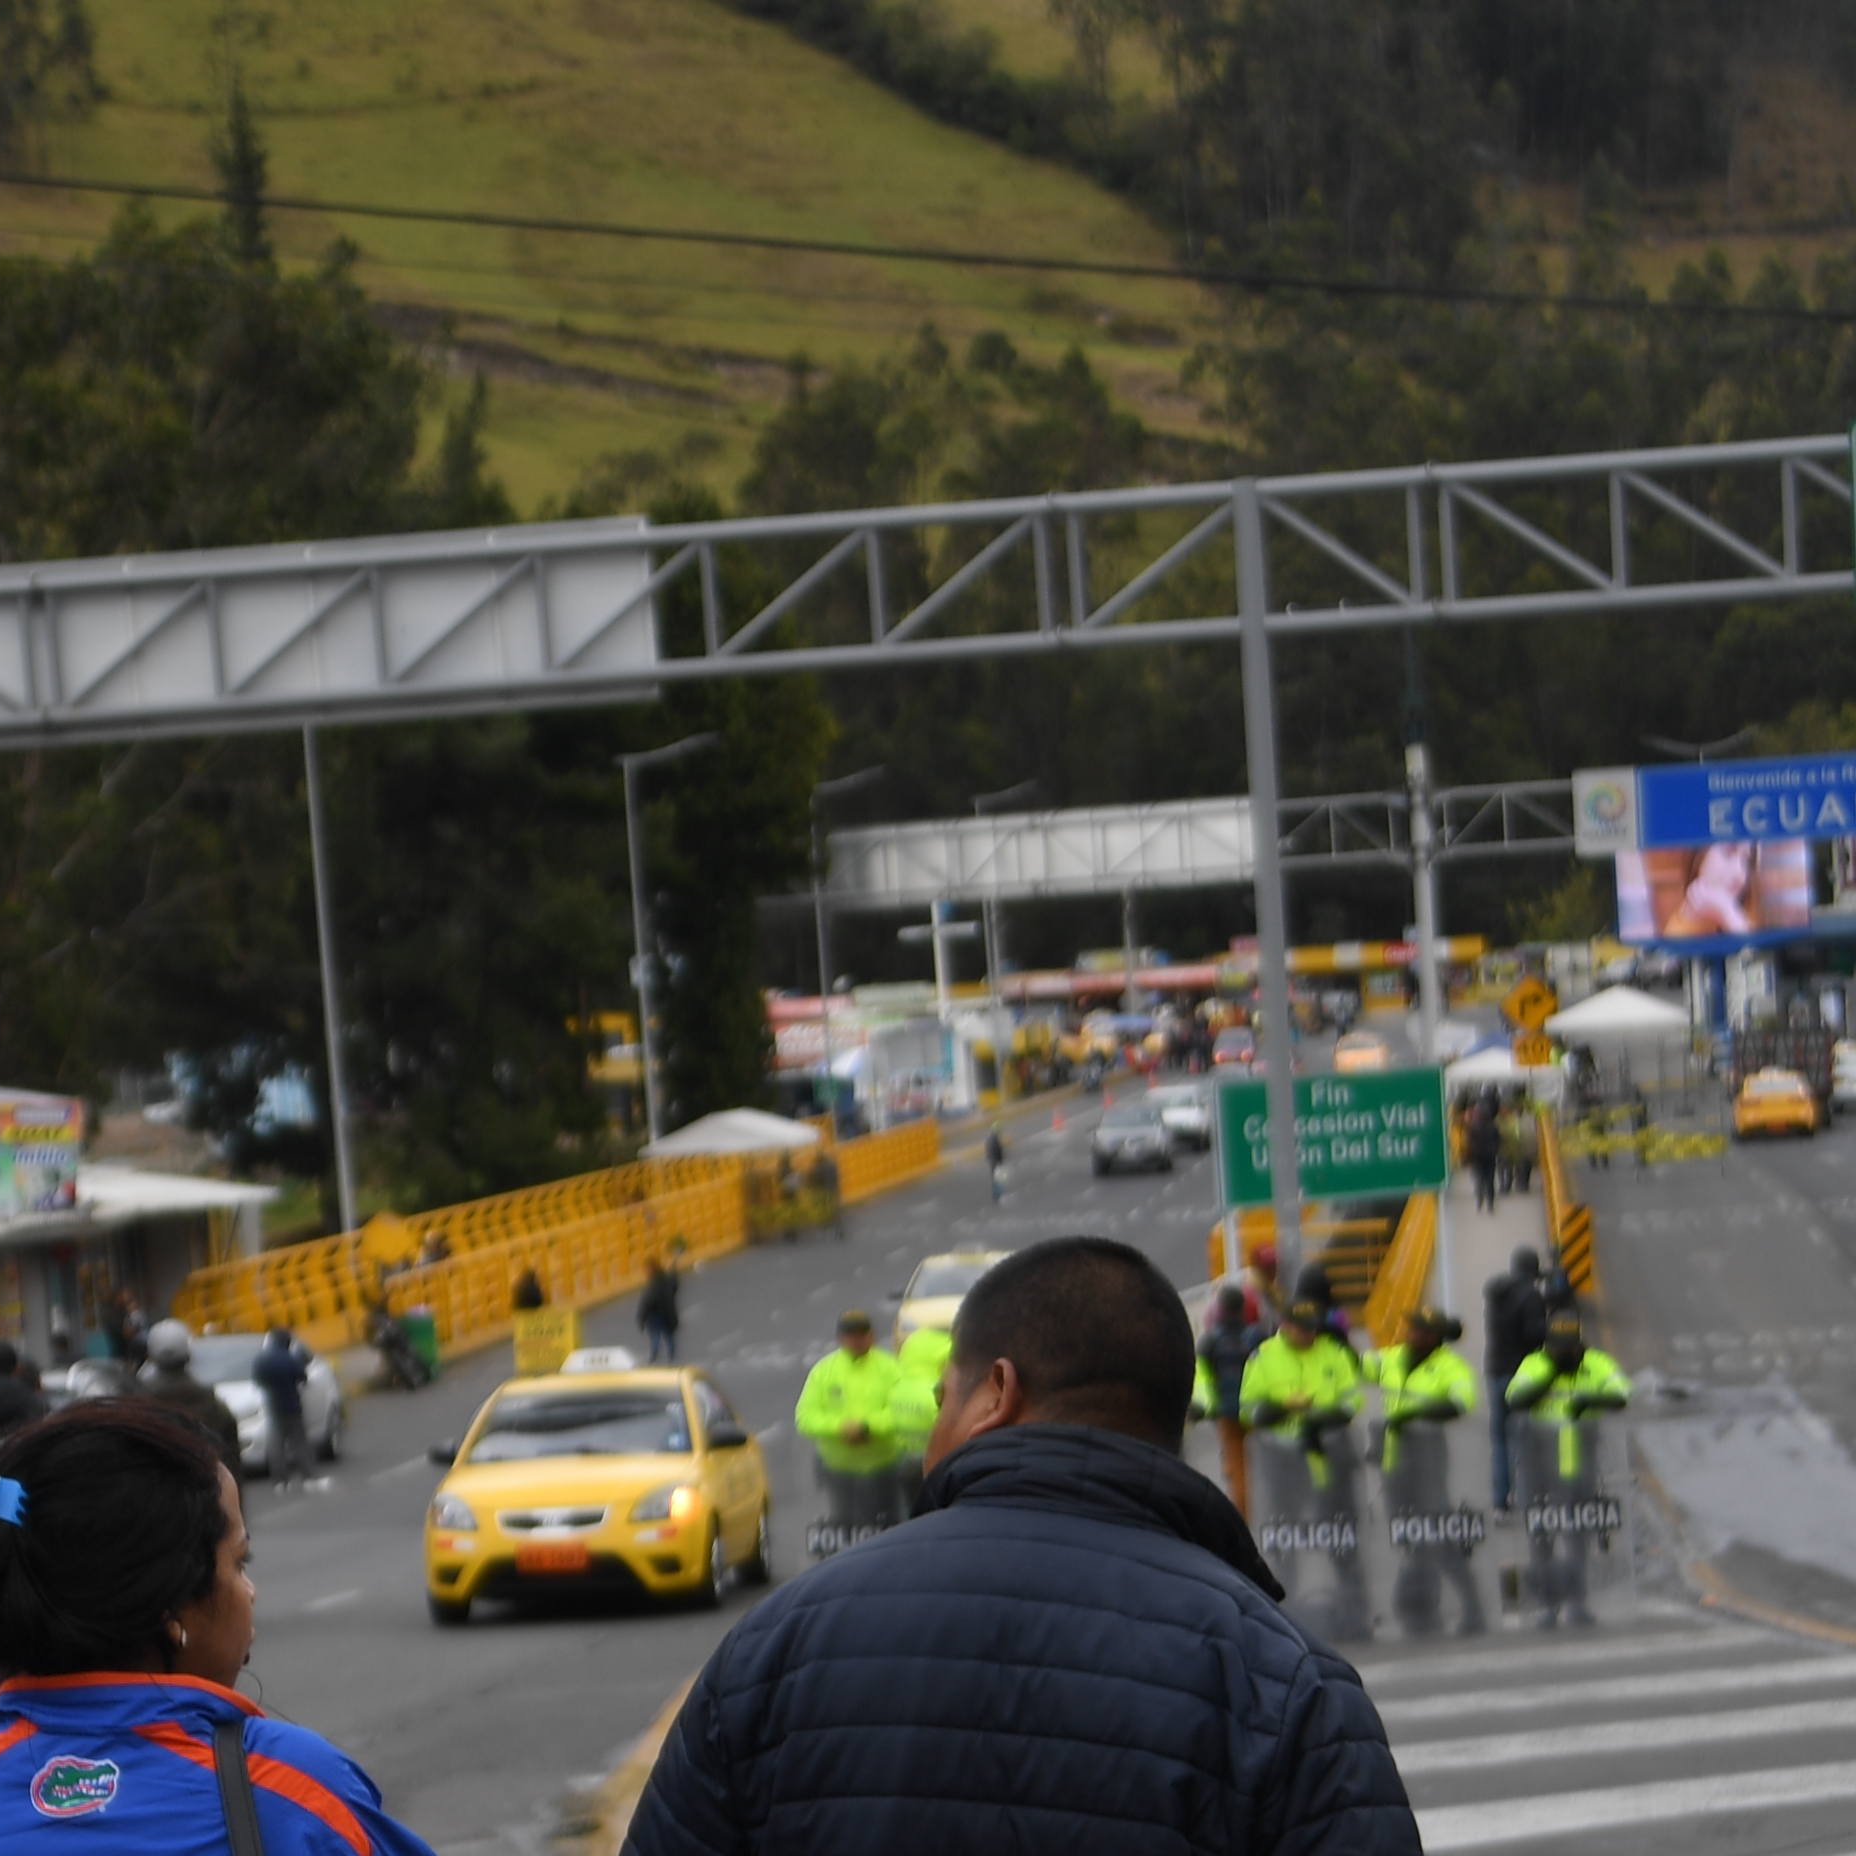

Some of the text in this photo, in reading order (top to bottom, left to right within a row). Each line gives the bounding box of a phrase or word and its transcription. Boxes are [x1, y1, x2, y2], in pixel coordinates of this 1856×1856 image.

[1310, 1079, 1349, 1108] Fin
[1380, 1102, 1426, 1130] Vial
[1331, 1134, 1369, 1164] Del
[1378, 1131, 1417, 1160] Sur
